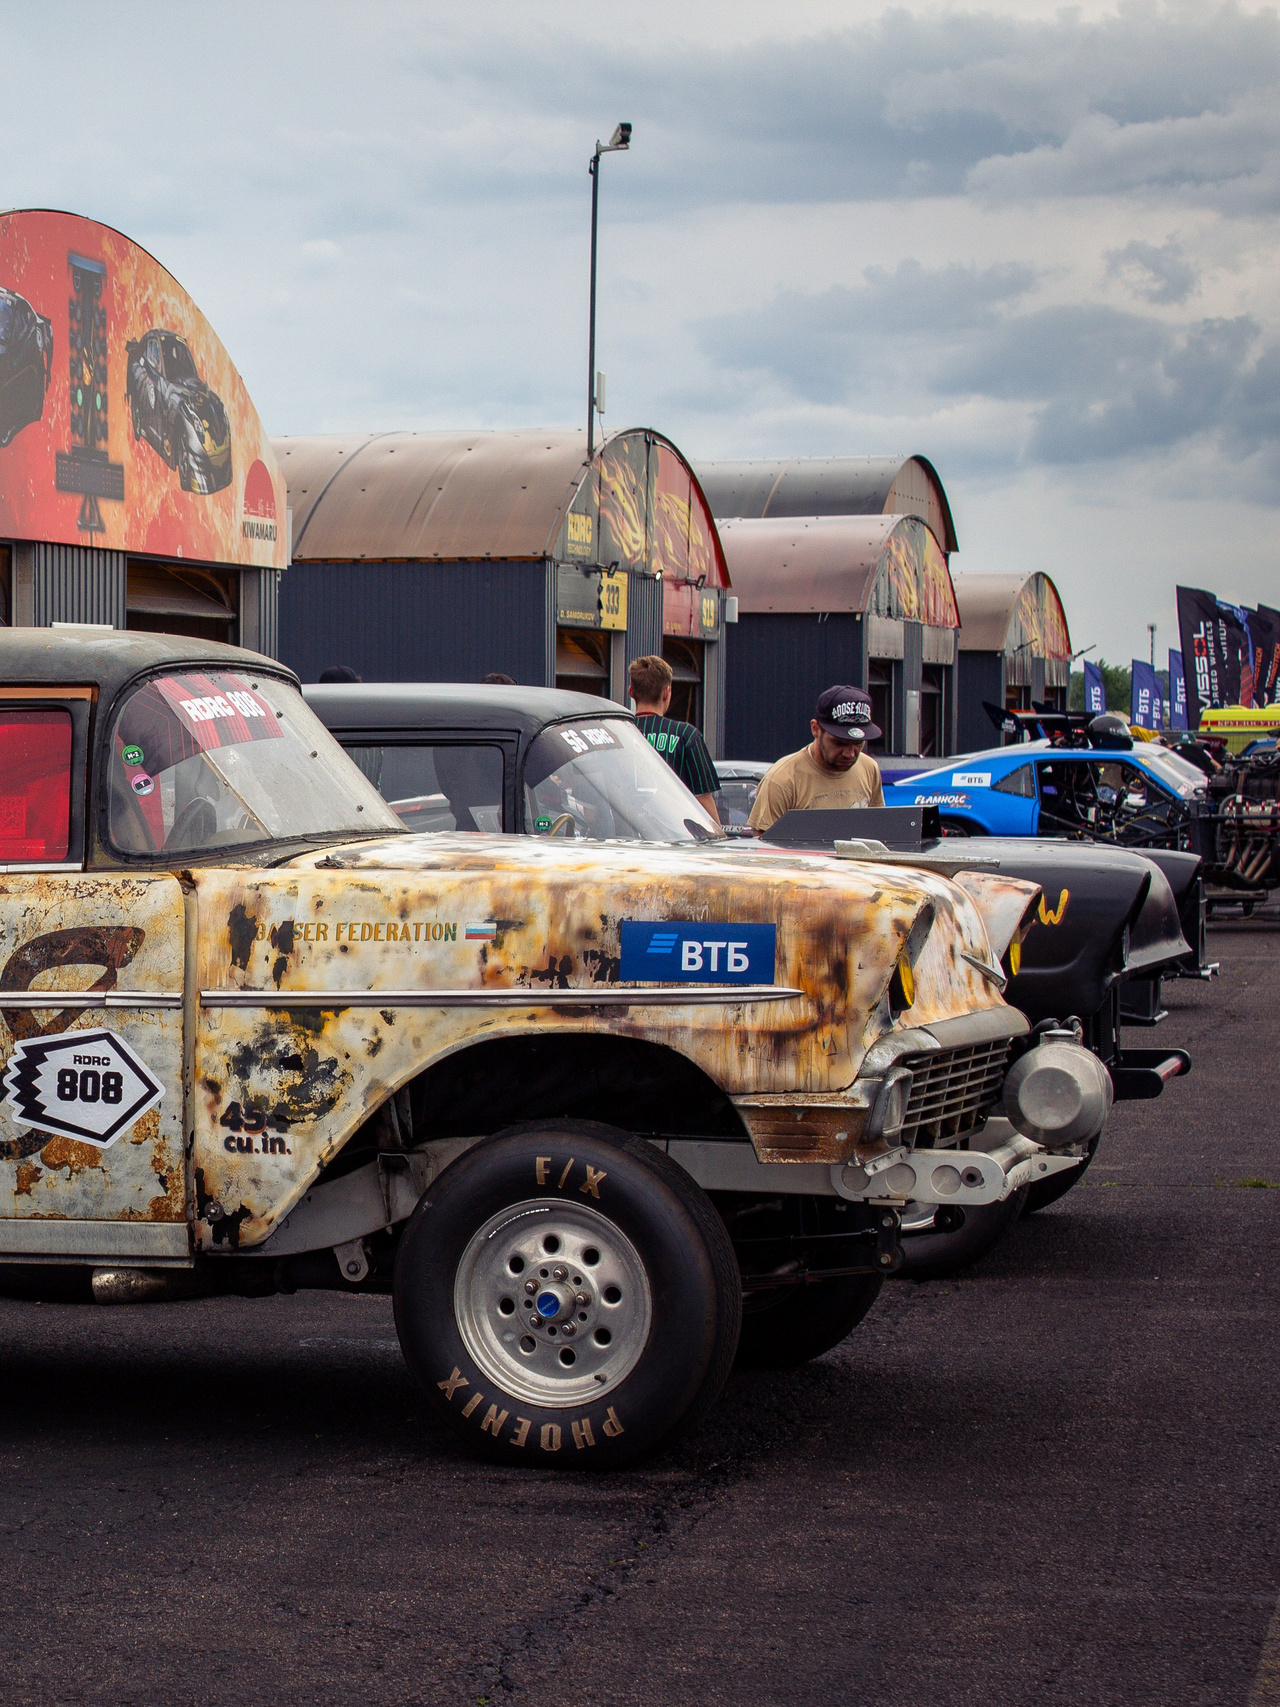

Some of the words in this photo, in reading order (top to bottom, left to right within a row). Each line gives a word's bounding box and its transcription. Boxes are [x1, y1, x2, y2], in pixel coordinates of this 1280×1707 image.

[242, 521, 278, 542] KIWAMARU
[1205, 620, 1217, 666] WHEELS
[1091, 686, 1102, 711] ВТБ
[1138, 688, 1150, 714] ВТБ
[643, 732, 680, 753] NOV
[967, 776, 984, 784] ВТБ
[336, 921, 458, 942] FEDERATION
[680, 940, 750, 973] ВТБ
[72, 1053, 111, 1067] RDRC
[56, 1068, 123, 1105] 808
[535, 1156, 607, 1199] F/X
[437, 1366, 625, 1451] PHOENIX
